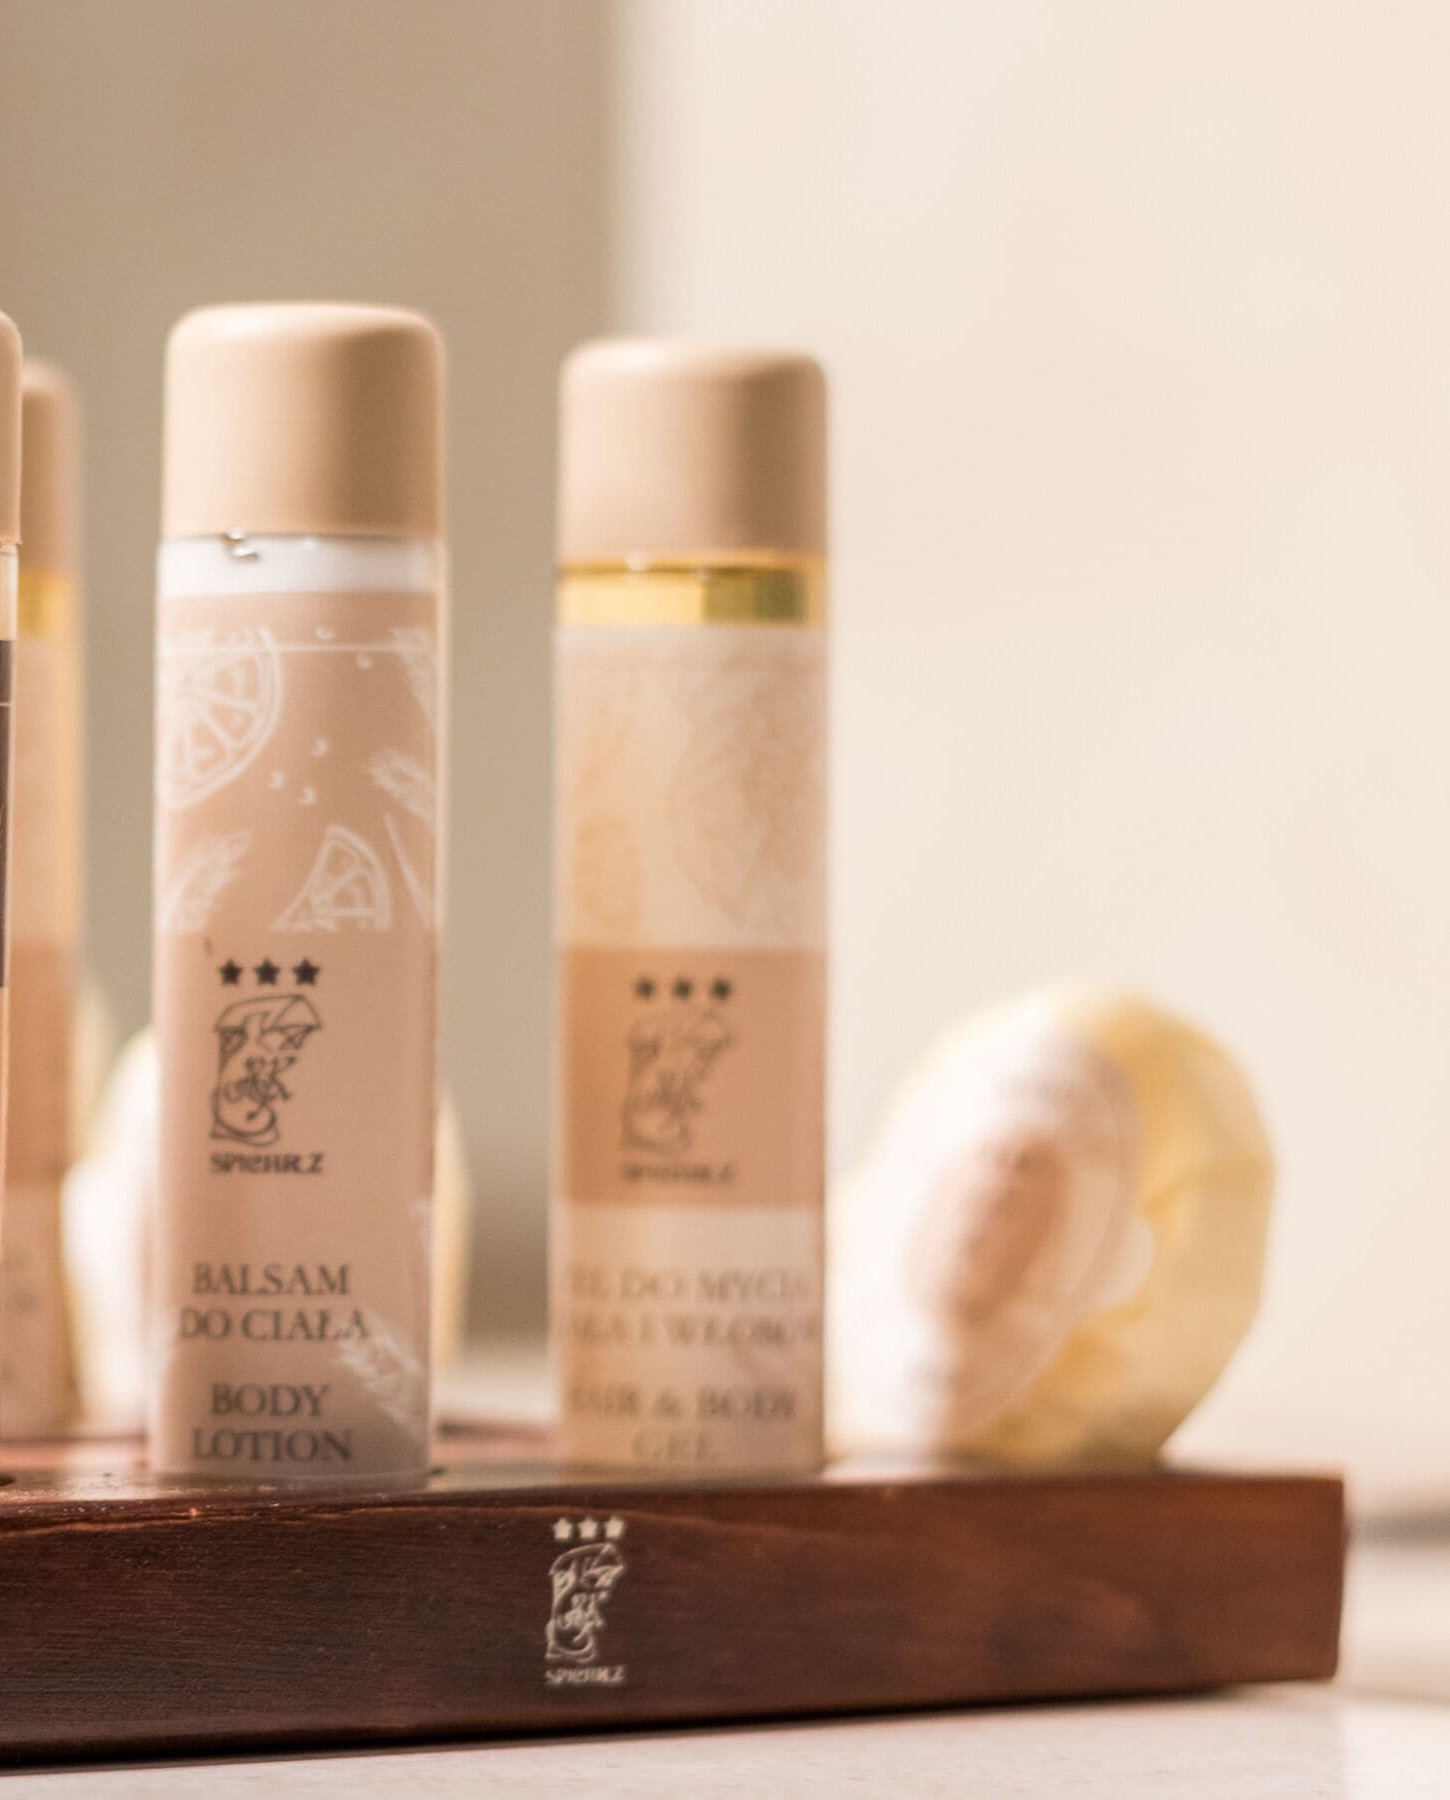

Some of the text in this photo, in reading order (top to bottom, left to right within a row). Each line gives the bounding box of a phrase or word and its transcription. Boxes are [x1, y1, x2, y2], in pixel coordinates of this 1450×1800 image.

[192, 1263, 349, 1296] BALSAM
[180, 1306, 370, 1341] DO CIAŁA
[210, 1383, 331, 1417] BODY
[192, 1428, 353, 1462] LOTION
